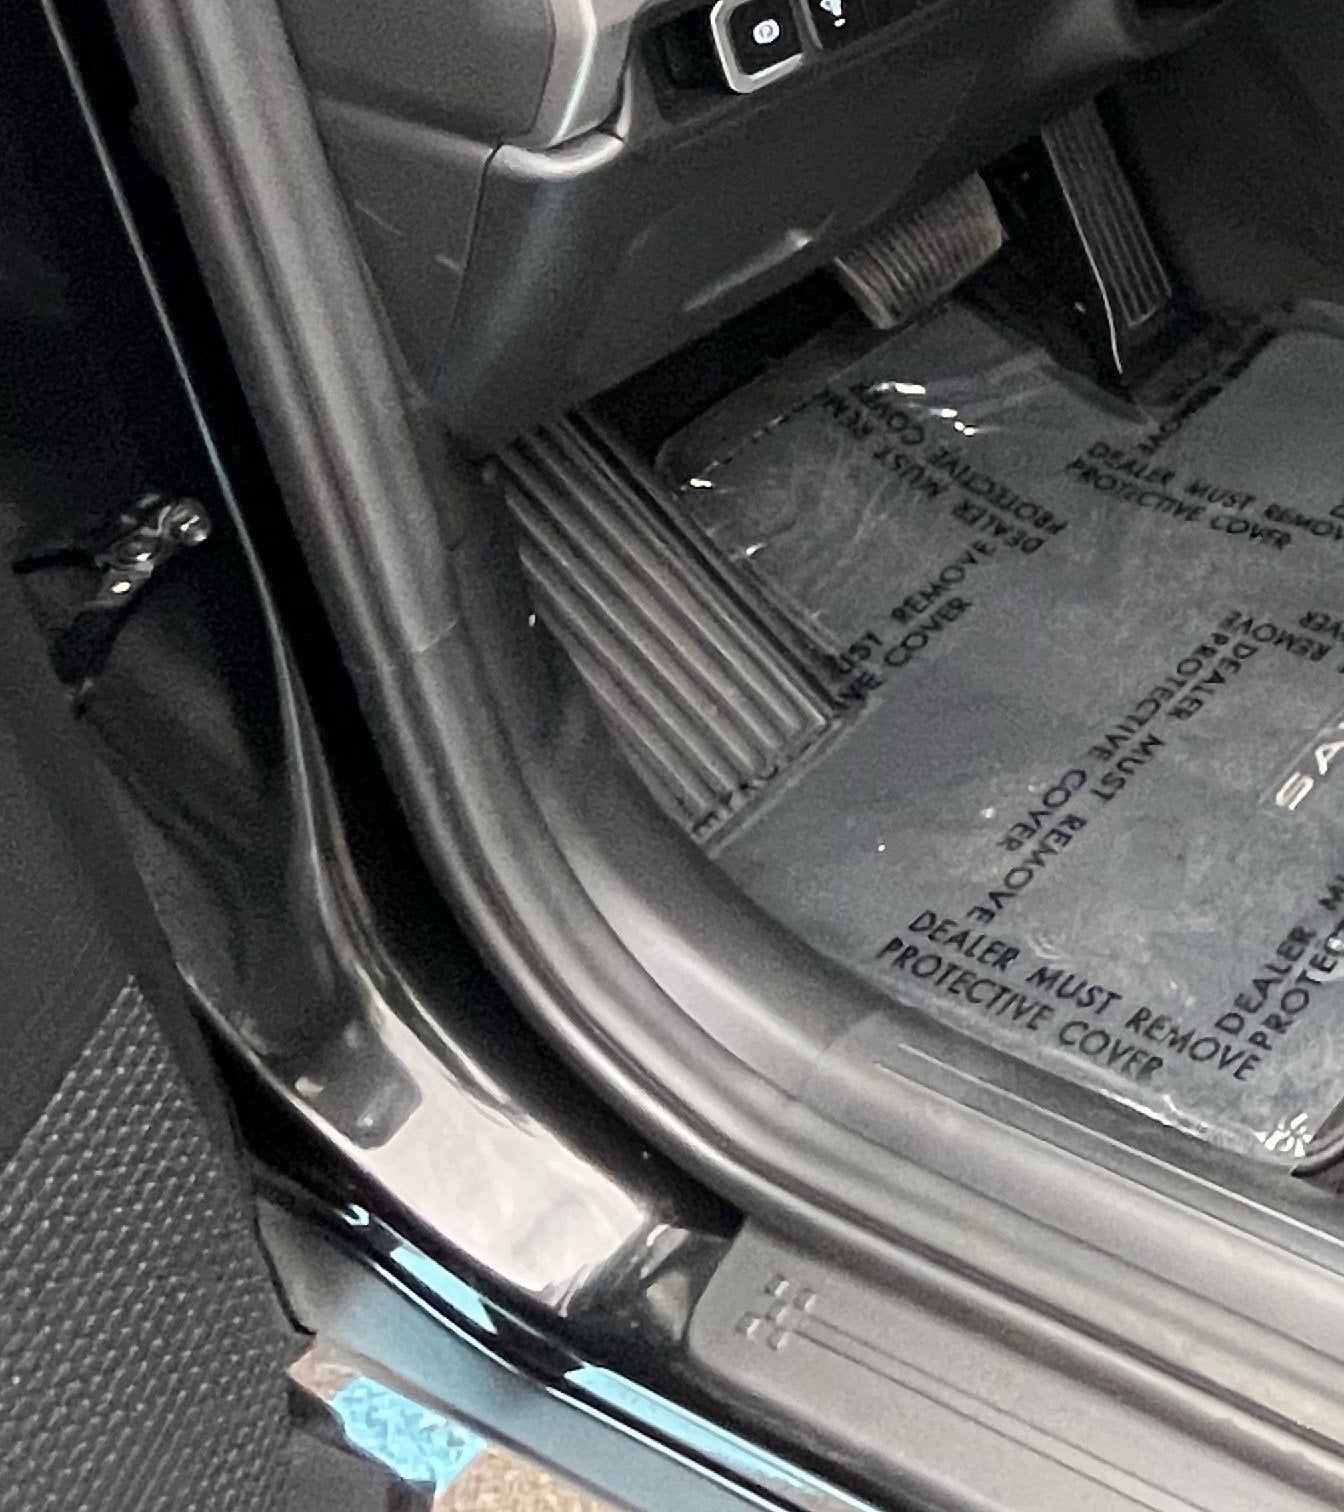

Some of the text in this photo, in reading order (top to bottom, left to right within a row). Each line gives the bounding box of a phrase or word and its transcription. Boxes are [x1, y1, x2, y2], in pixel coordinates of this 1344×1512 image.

[1066, 457, 1293, 551] PROTECTIVE COVER
[1088, 441, 1176, 486] DEALER
[1184, 481, 1257, 511] MUST
[952, 498, 1045, 565] DEALER
[891, 540, 998, 624] REMOVE
[884, 597, 974, 668] COVER
[1218, 610, 1332, 663] REMOVE
[966, 641, 1259, 924] DEALER MUST REMOVE
[996, 631, 1230, 852] PROTECTIVE COVER
[876, 936, 1165, 1083] PROTECTIVE COVER
[908, 910, 1262, 1083] DEALER MUST REMOVE
[1214, 925, 1318, 1037] DEALER
